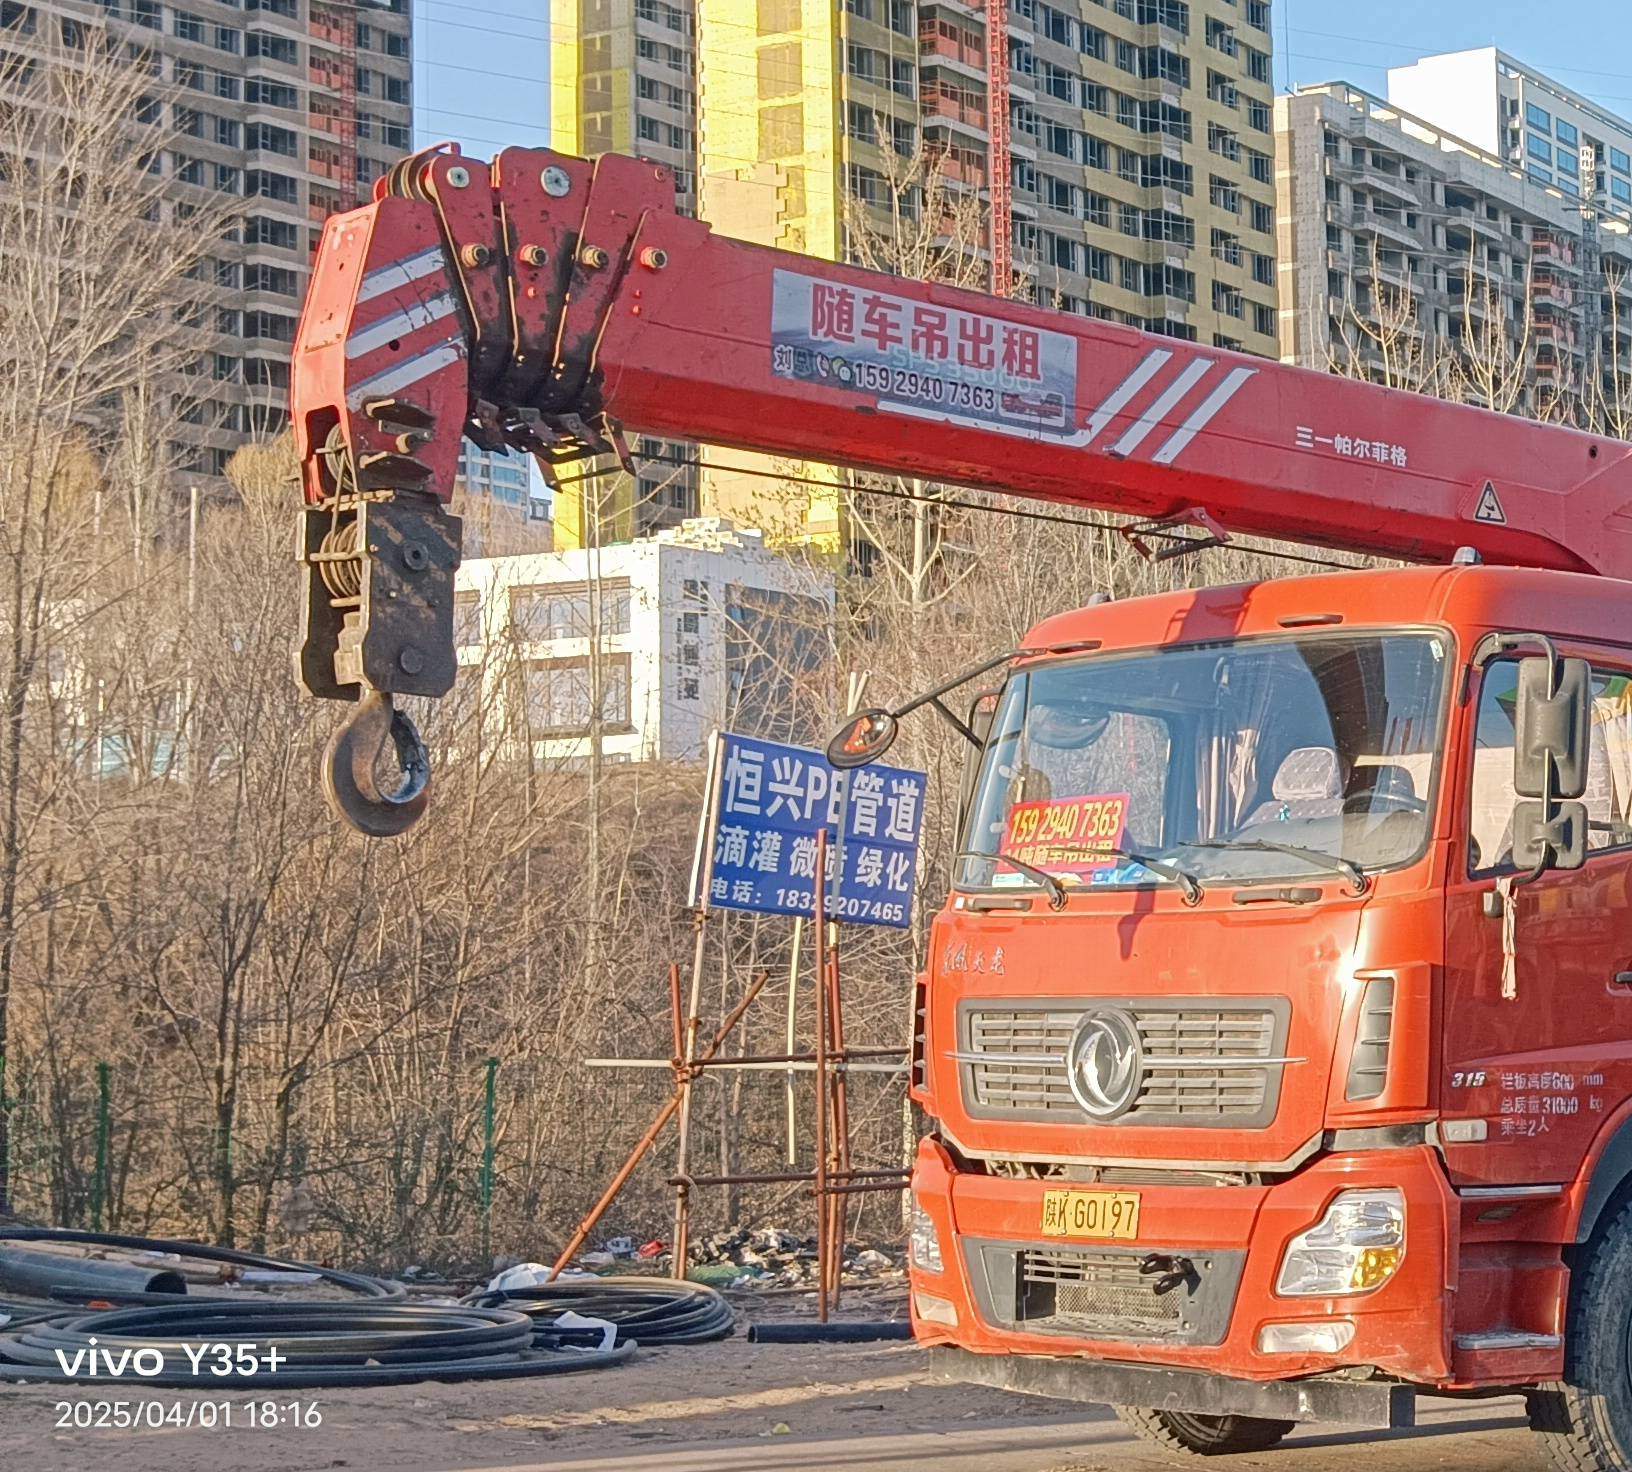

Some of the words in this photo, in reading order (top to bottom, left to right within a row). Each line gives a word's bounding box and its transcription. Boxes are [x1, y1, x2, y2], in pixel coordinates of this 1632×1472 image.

[811, 283, 1041, 381] 随车吊出租
[854, 362, 890, 389] 159
[895, 370, 944, 400] 2940
[949, 381, 996, 411] 7363
[1295, 425, 1408, 468] 三一帕尔菲格
[724, 744, 920, 842] 恒兴PE管道
[1010, 808, 1041, 844] 159
[1037, 803, 1080, 841] 2940
[1079, 799, 1123, 838] 7363
[715, 824, 783, 873] 滴灌
[855, 846, 911, 892] 绿化
[1451, 1071, 1487, 1088] 315
[1501, 1116, 1549, 1137] 乘坐2人
